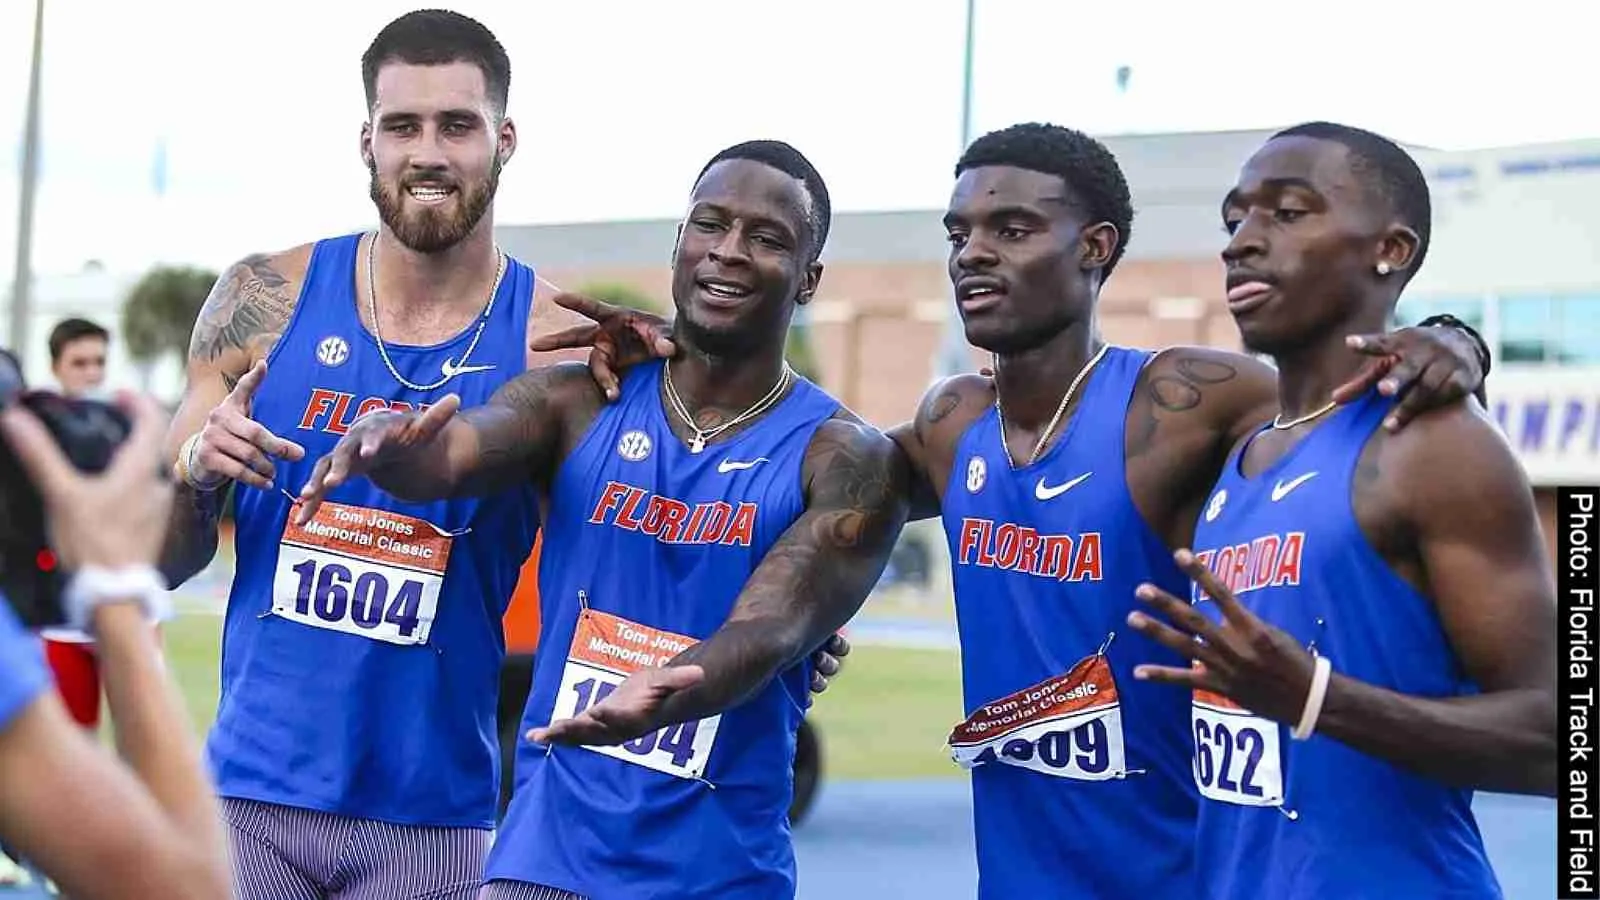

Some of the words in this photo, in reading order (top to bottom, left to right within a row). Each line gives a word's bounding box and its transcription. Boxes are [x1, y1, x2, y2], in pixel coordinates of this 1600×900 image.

[318, 335, 349, 367] SEC
[618, 431, 651, 462] SEC
[333, 507, 364, 524] Tom
[367, 512, 414, 536] Jones
[588, 481, 757, 546] FLORIDA
[304, 521, 374, 546] Memorial
[377, 535, 433, 559] Classic
[292, 559, 425, 637] 1604
[590, 637, 654, 667] Memorial
[615, 622, 648, 645] Tom
[651, 637, 689, 653] Jone
[983, 701, 1019, 717] Tom
[1039, 682, 1099, 710] Classic
[573, 677, 701, 768] 14
